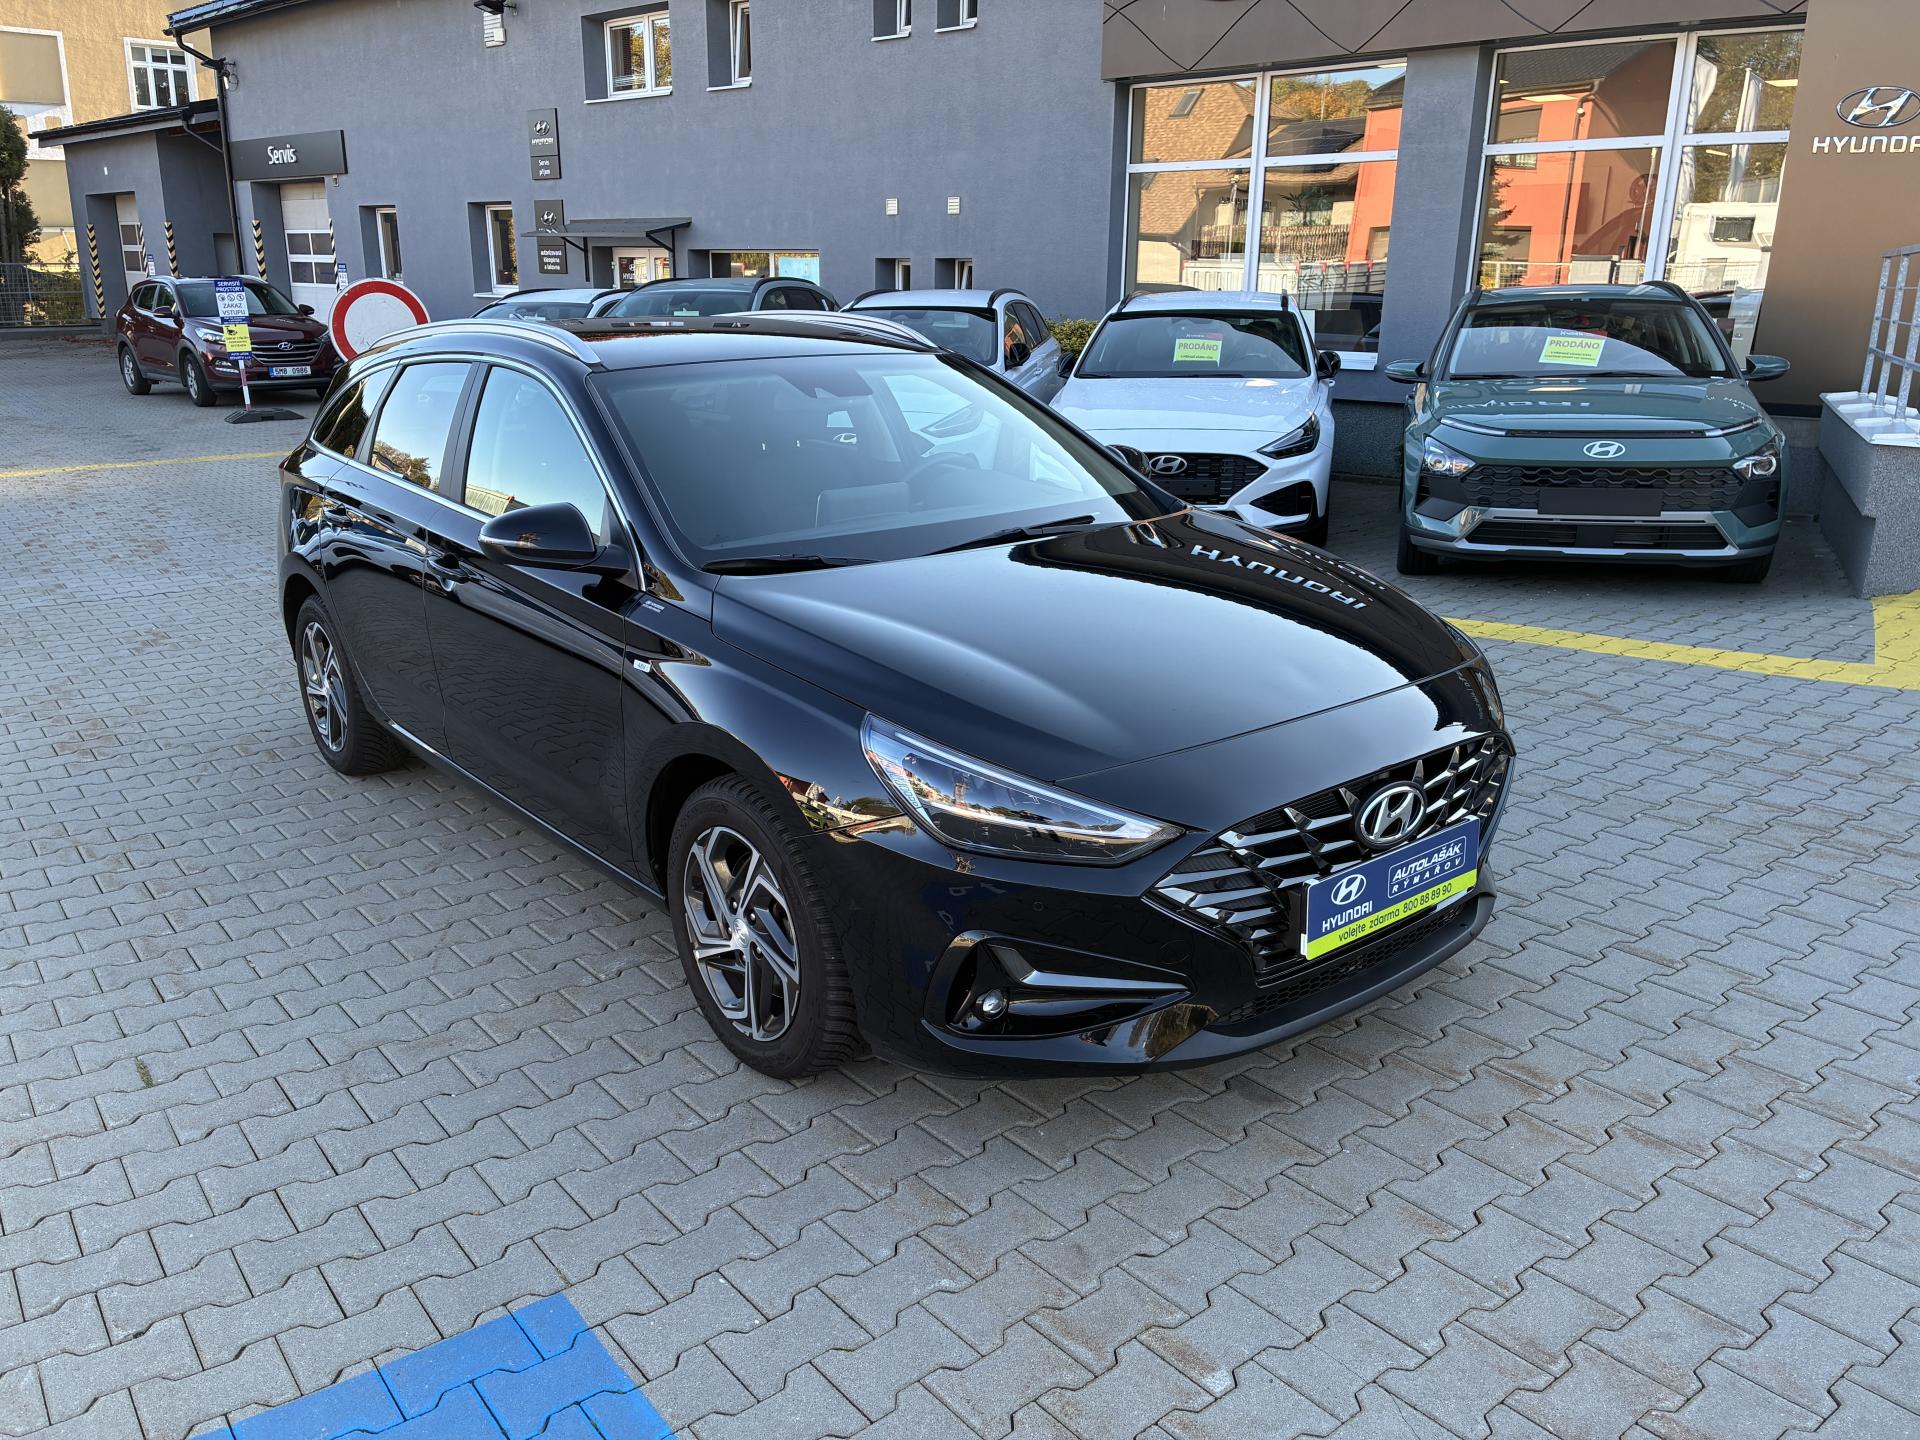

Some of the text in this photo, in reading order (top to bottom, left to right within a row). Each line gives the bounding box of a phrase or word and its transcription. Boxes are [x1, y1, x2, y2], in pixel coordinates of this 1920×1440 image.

[267, 144, 297, 165] Servis
[1178, 341, 1219, 351] PRODÁNO
[1549, 339, 1600, 350] PRODÁNO
[1391, 842, 1462, 883] AUTOLAŠÁK
[1391, 857, 1462, 894] RÝMAŘOV
[1322, 900, 1373, 933] HYUNDAI
[1338, 882, 1453, 943] volejte zdarma 800 88 89 90
